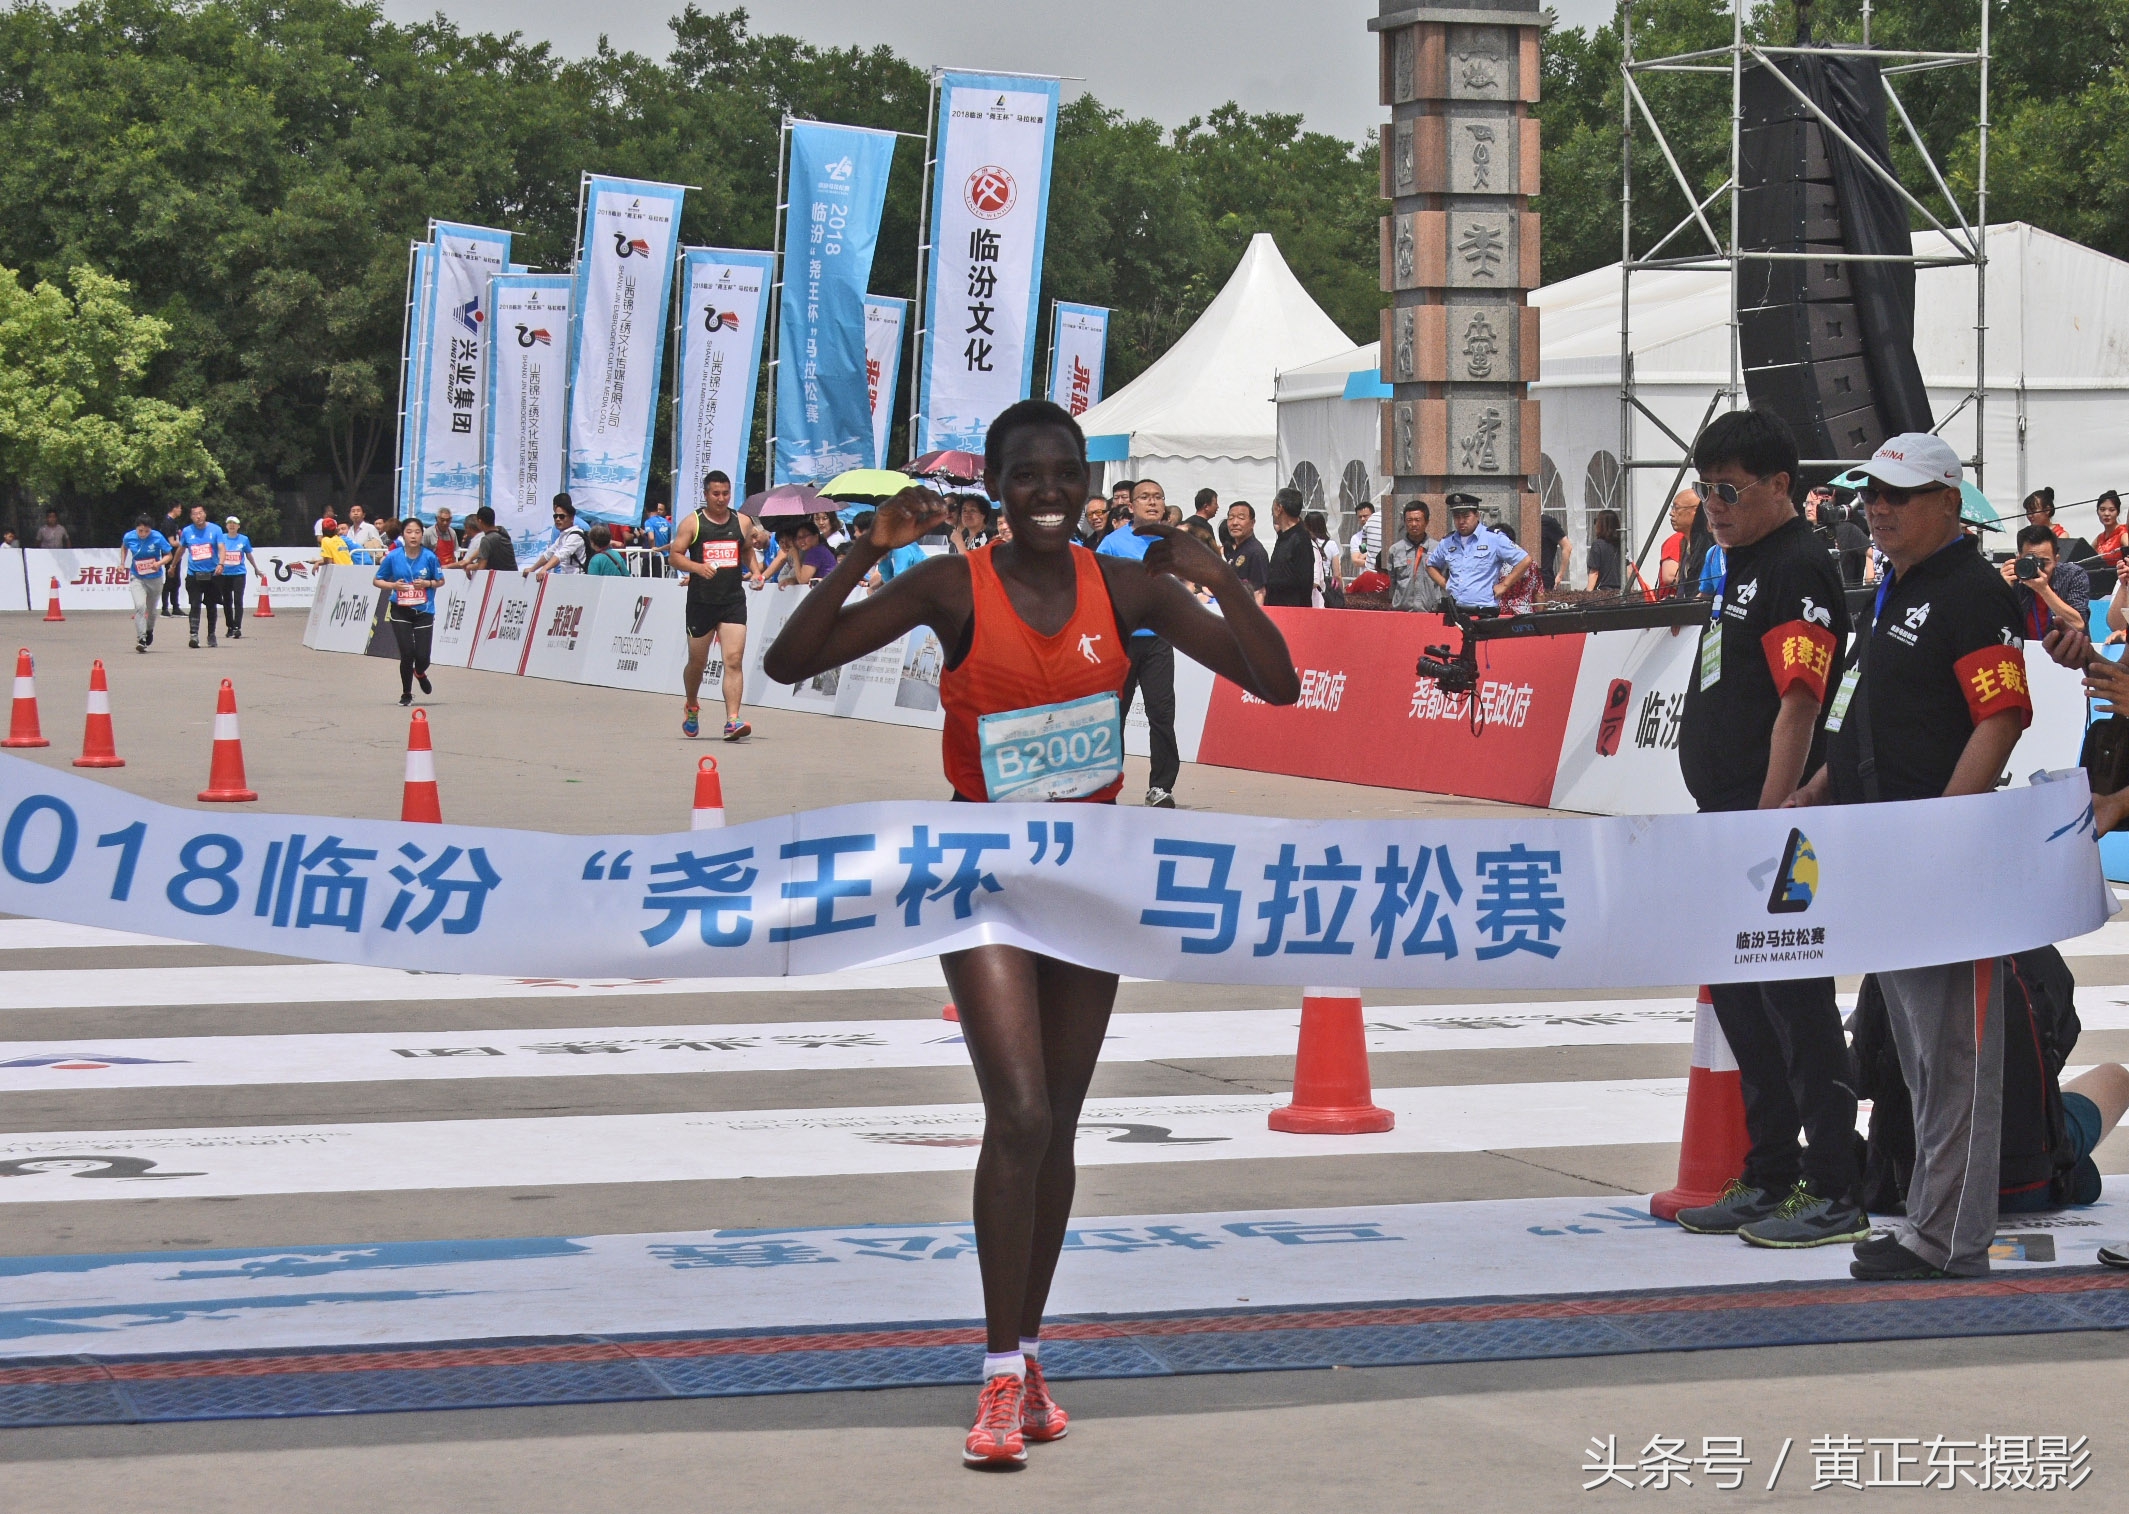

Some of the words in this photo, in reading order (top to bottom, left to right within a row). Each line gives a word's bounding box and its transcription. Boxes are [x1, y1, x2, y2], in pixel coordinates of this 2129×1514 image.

[825, 203, 848, 256] 2018
[963, 228, 1002, 373] 临汾文化
[608, 274, 636, 428] 山西锦之绣文化传媒有限公司
[447, 373, 455, 404] GROUP
[451, 338, 478, 434] 兴业集团
[526, 363, 541, 506] 山西锦之绣文化传媒有限公司
[1876, 449, 1904, 461] CHINA
[706, 549, 736, 559] C3167
[71, 566, 131, 585] 来跑
[330, 587, 370, 627] AnyTalk
[547, 604, 583, 638] 来跑吧
[498, 625, 522, 641] MARARUN
[632, 637, 654, 657] CENTER
[1782, 635, 1832, 684] 竞赛主
[1971, 660, 2031, 704] 主裁
[995, 726, 1111, 779] B2002
[1734, 952, 1768, 964] LINFEN
[1770, 949, 1825, 962] MARATHON
[1736, 926, 1825, 950] 临汾马拉松赛
